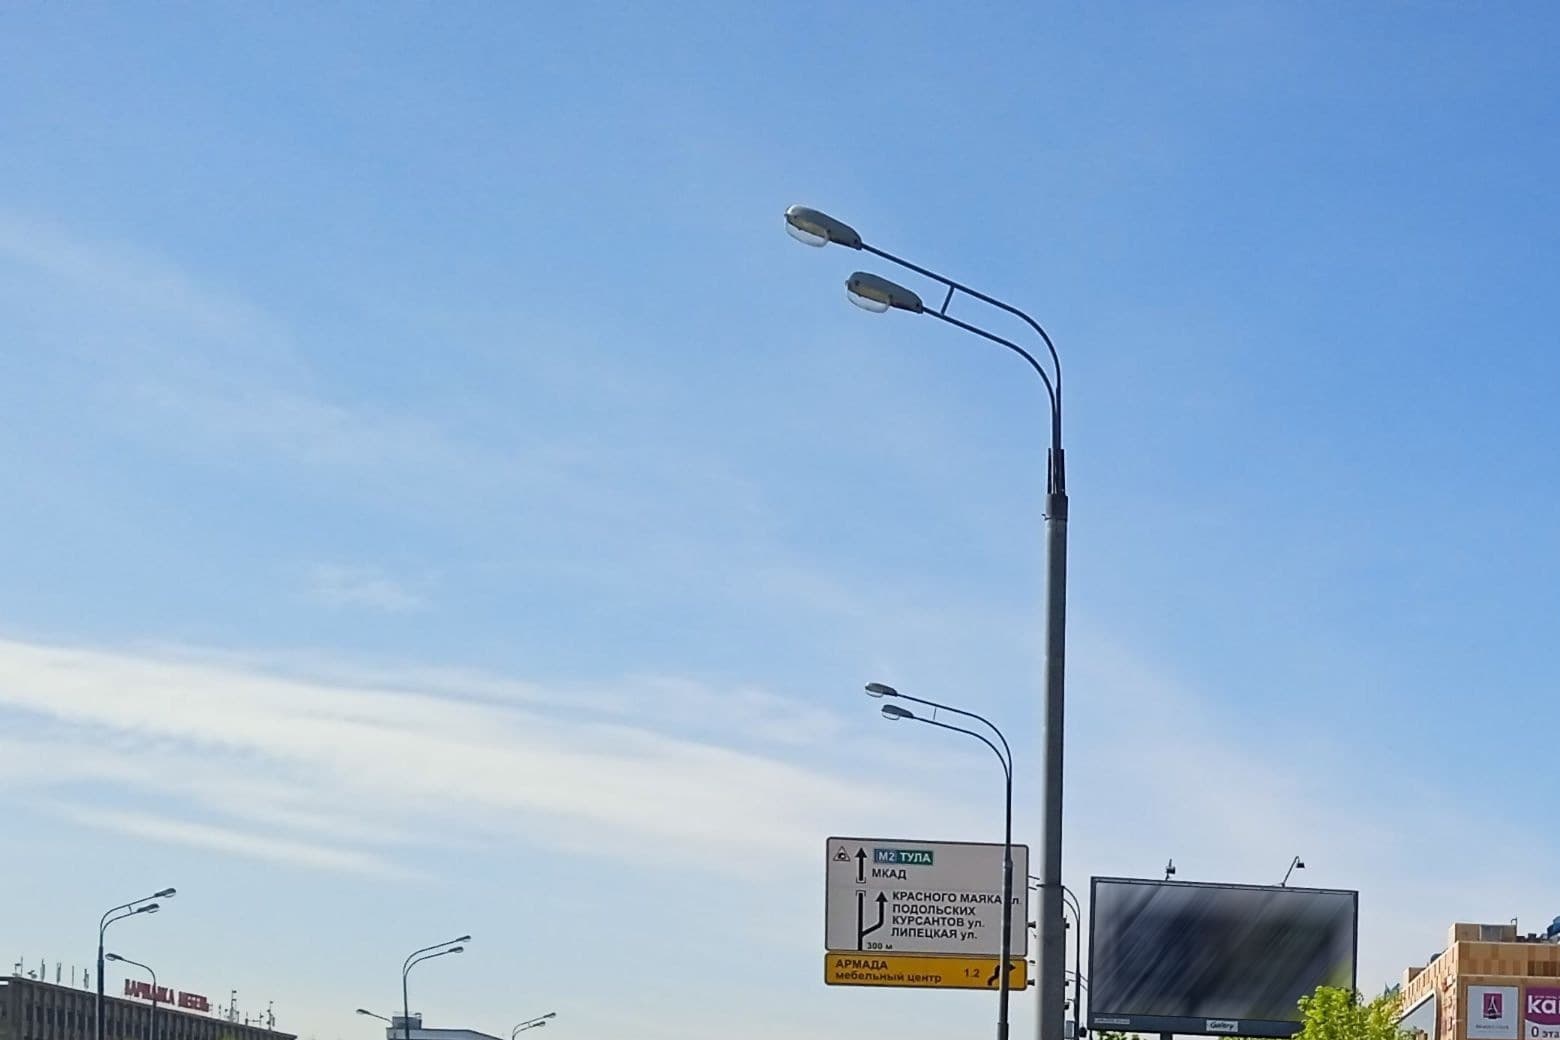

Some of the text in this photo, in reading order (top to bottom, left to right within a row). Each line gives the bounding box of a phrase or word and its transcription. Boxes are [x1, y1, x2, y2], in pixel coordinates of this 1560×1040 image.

[901, 852, 931, 863] ТУЛА
[872, 868, 907, 880] МКАД
[893, 892, 957, 903] КРАСНОГО
[961, 894, 1002, 904] МАЯКА
[893, 904, 976, 916] ПОДОЛЬСКИХ
[892, 916, 985, 930] КУРСАНТОВ ул.
[891, 928, 978, 941] ЛИПЕЦКАЯ ул.
[867, 942, 883, 950] 300
[835, 959, 888, 970] АРМАДА
[835, 970, 941, 984] мебельный центр
[1531, 1026, 1540, 1038] 0
